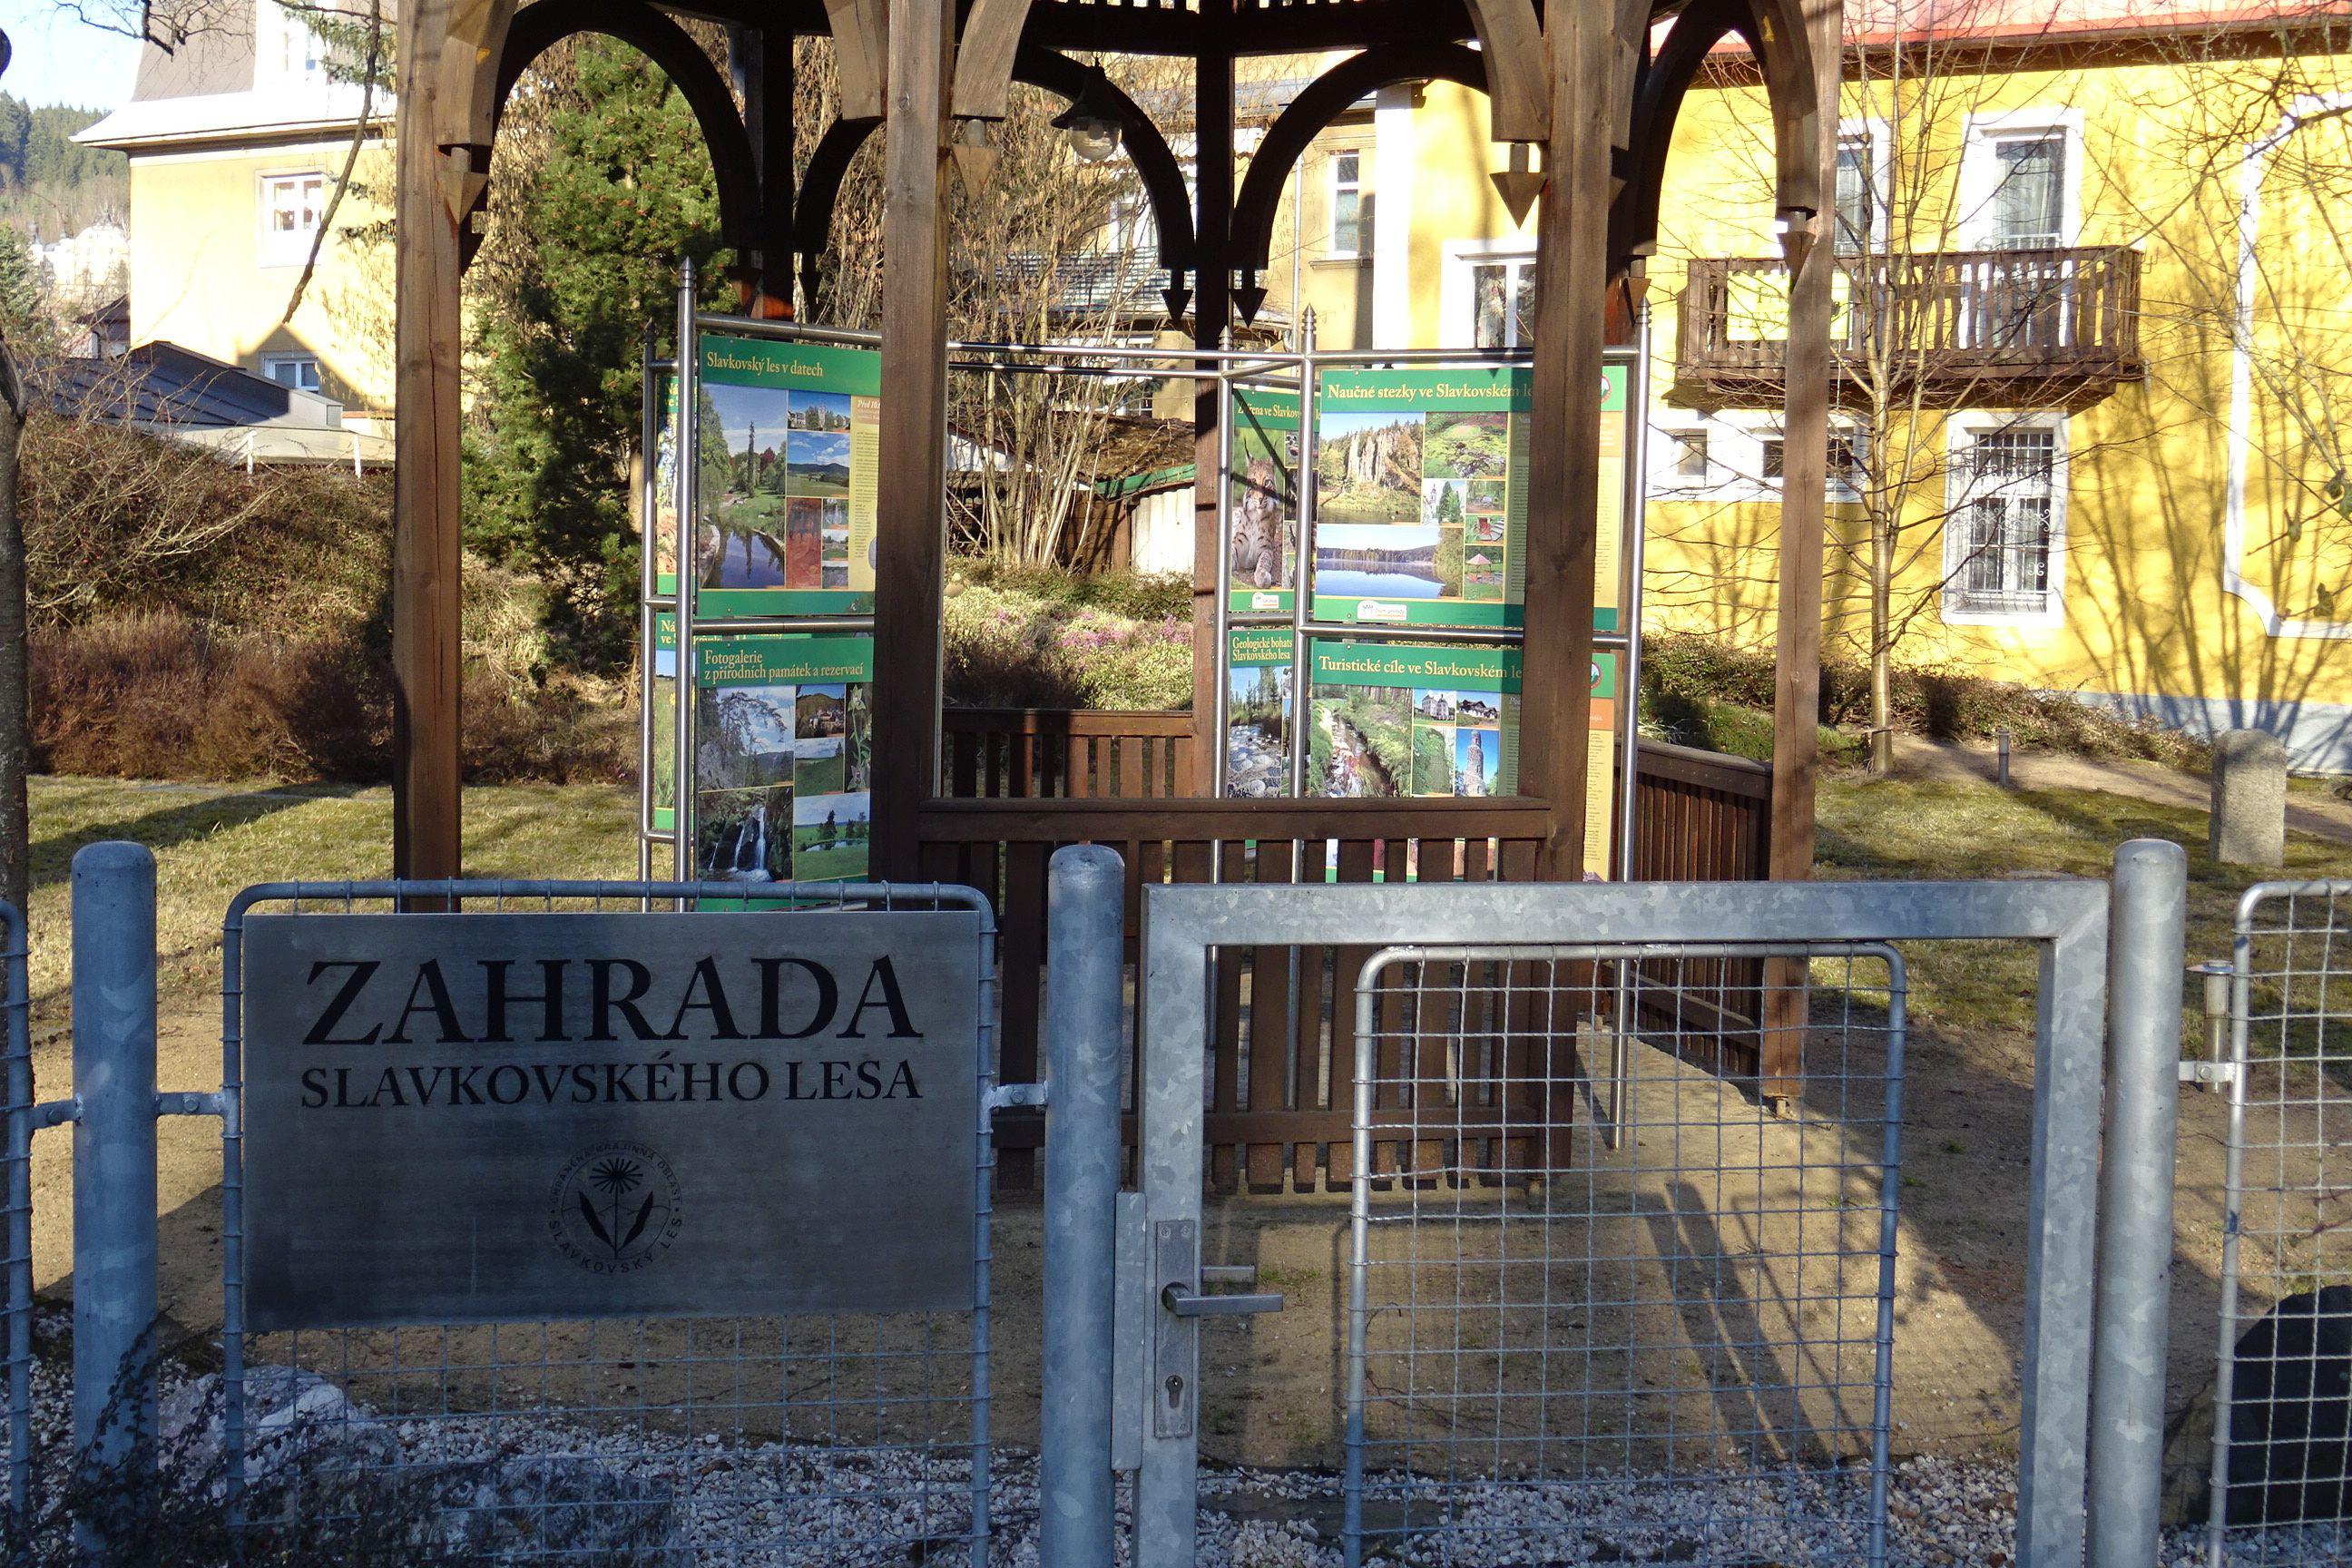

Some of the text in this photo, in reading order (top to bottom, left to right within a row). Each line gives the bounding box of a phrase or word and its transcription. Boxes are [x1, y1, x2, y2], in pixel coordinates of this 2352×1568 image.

[707, 351, 824, 377] Slavkovský les v datech
[1328, 384, 1376, 398] Naučné
[1377, 384, 1416, 402] stezky
[1418, 387, 1434, 398] ve
[1436, 383, 1519, 398] Slavkovském
[1264, 407, 1272, 416] ve
[1232, 636, 1293, 652] Geologické bohats
[1232, 648, 1291, 662] Slavkovského lesa
[704, 649, 763, 669] Fotogalerie
[1318, 655, 1381, 672] Turistické
[1383, 659, 1406, 673] cíle
[1406, 663, 1422, 674] ve
[1424, 661, 1508, 678] Slavkovském
[704, 662, 864, 684] z přírodních památek a rezervací
[301, 953, 924, 1045] ZAHRADA
[300, 1050, 924, 1109] SLAVKOVSKÉHO LESA
[660, 1217, 683, 1250] LES
